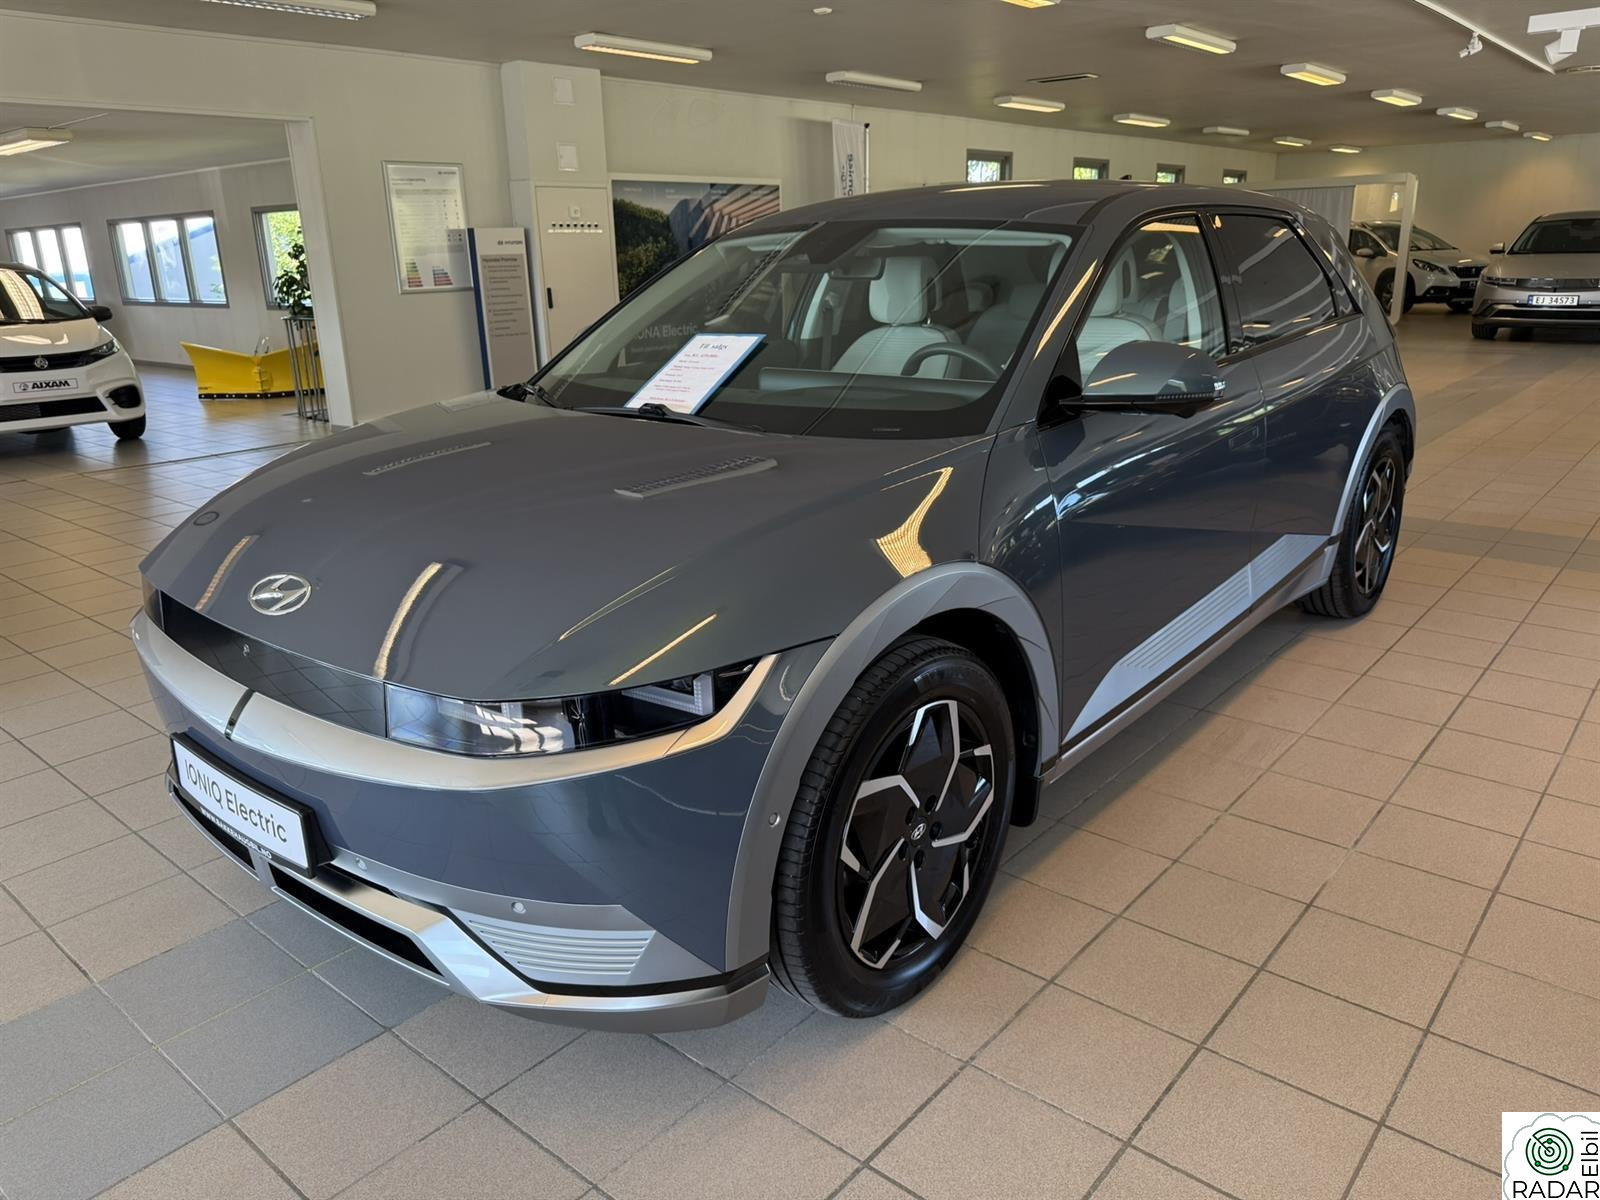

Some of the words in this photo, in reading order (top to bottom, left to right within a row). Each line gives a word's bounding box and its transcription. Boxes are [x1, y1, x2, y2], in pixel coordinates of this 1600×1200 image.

[662, 322, 697, 338] Electric
[31, 380, 70, 390] AIXAM
[184, 759, 224, 810] IONIQ
[224, 788, 288, 843] Electric
